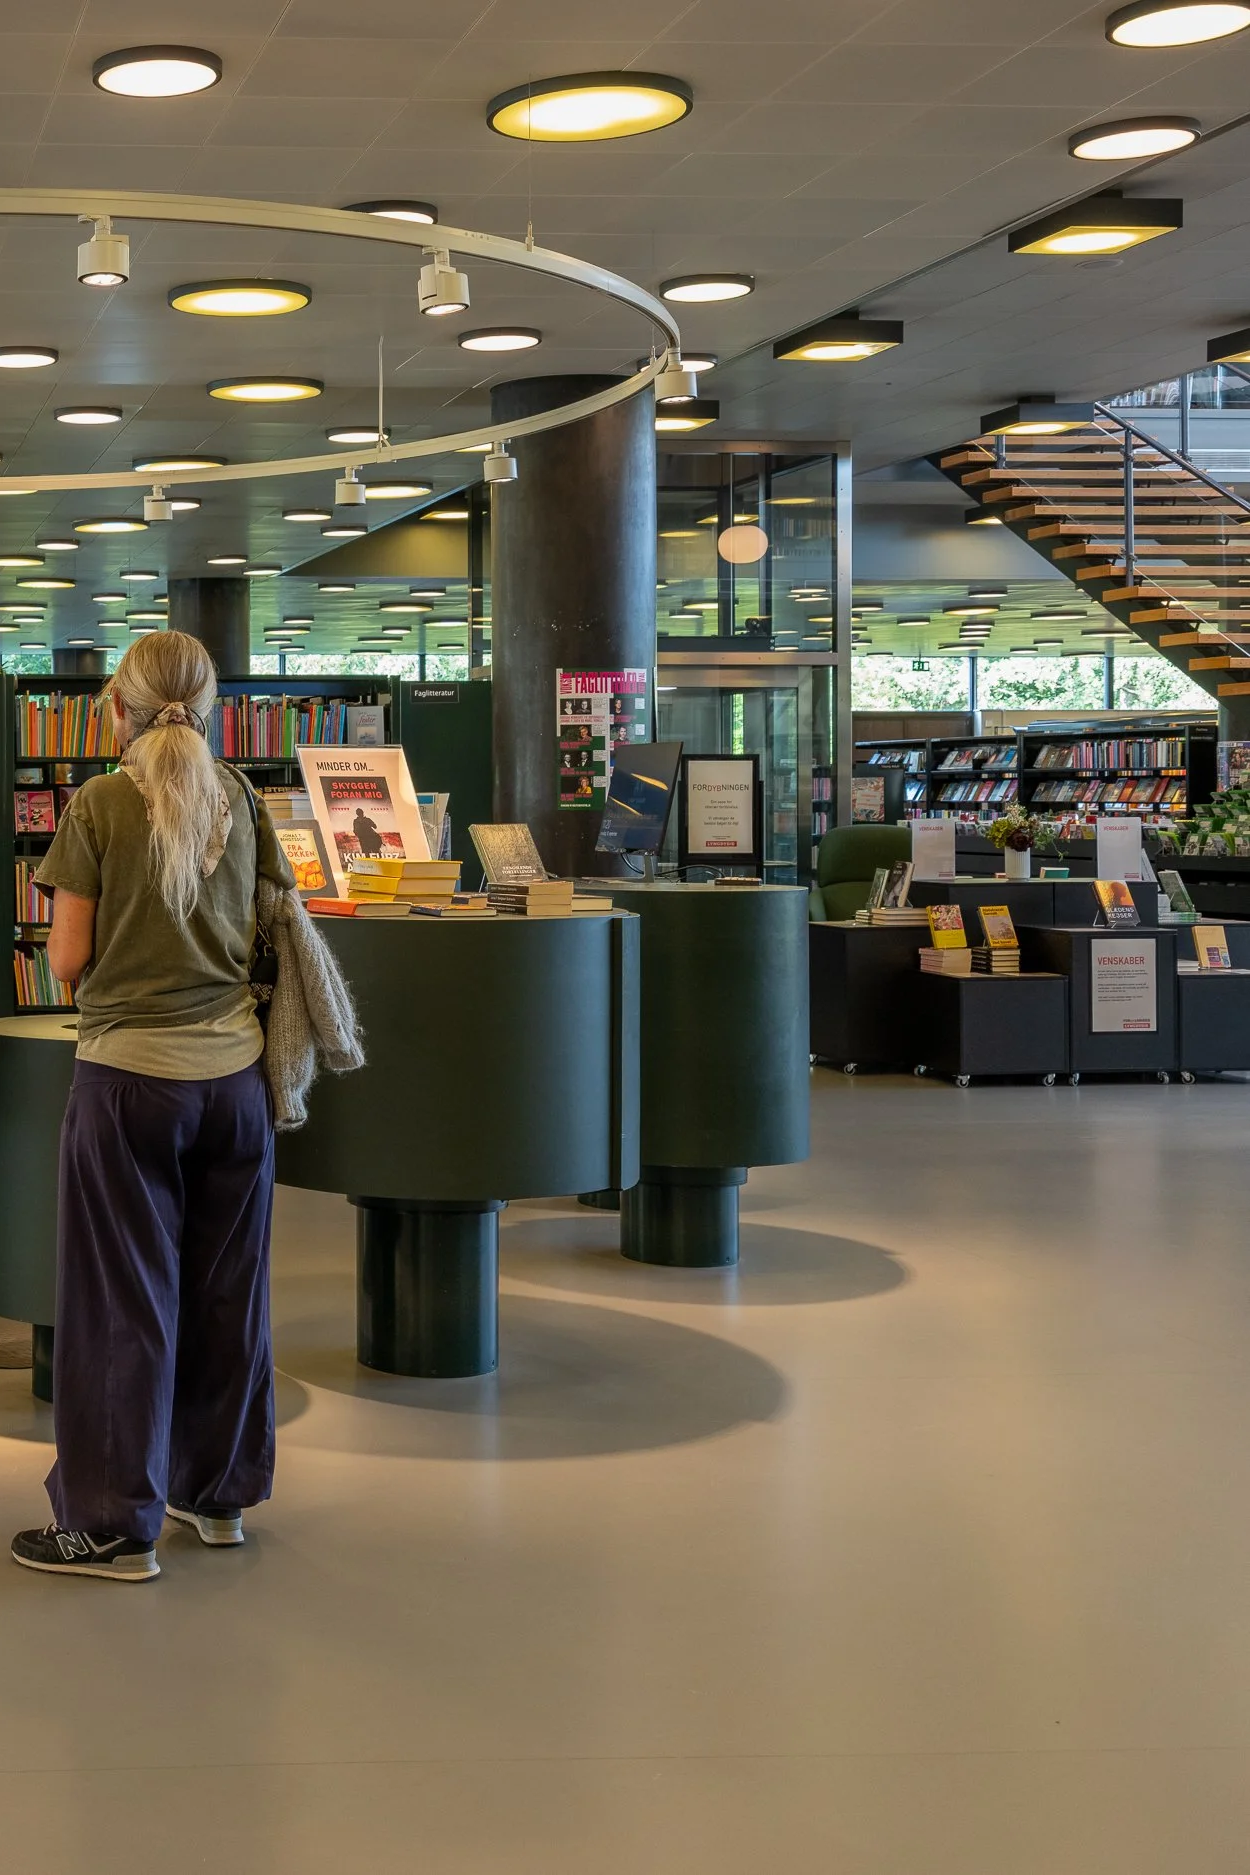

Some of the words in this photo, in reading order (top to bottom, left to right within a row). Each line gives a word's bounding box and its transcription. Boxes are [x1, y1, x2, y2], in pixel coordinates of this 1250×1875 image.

[414, 690, 454, 698] Faglitteratur
[316, 762, 351, 772] MINDER
[332, 782, 377, 790] SKYGGEN
[692, 784, 749, 792] FORDYBNINGEN
[330, 791, 362, 799] FORAN
[364, 791, 383, 799] MIG
[343, 853, 366, 863] KIM
[1097, 957, 1145, 966] VENSKABER
